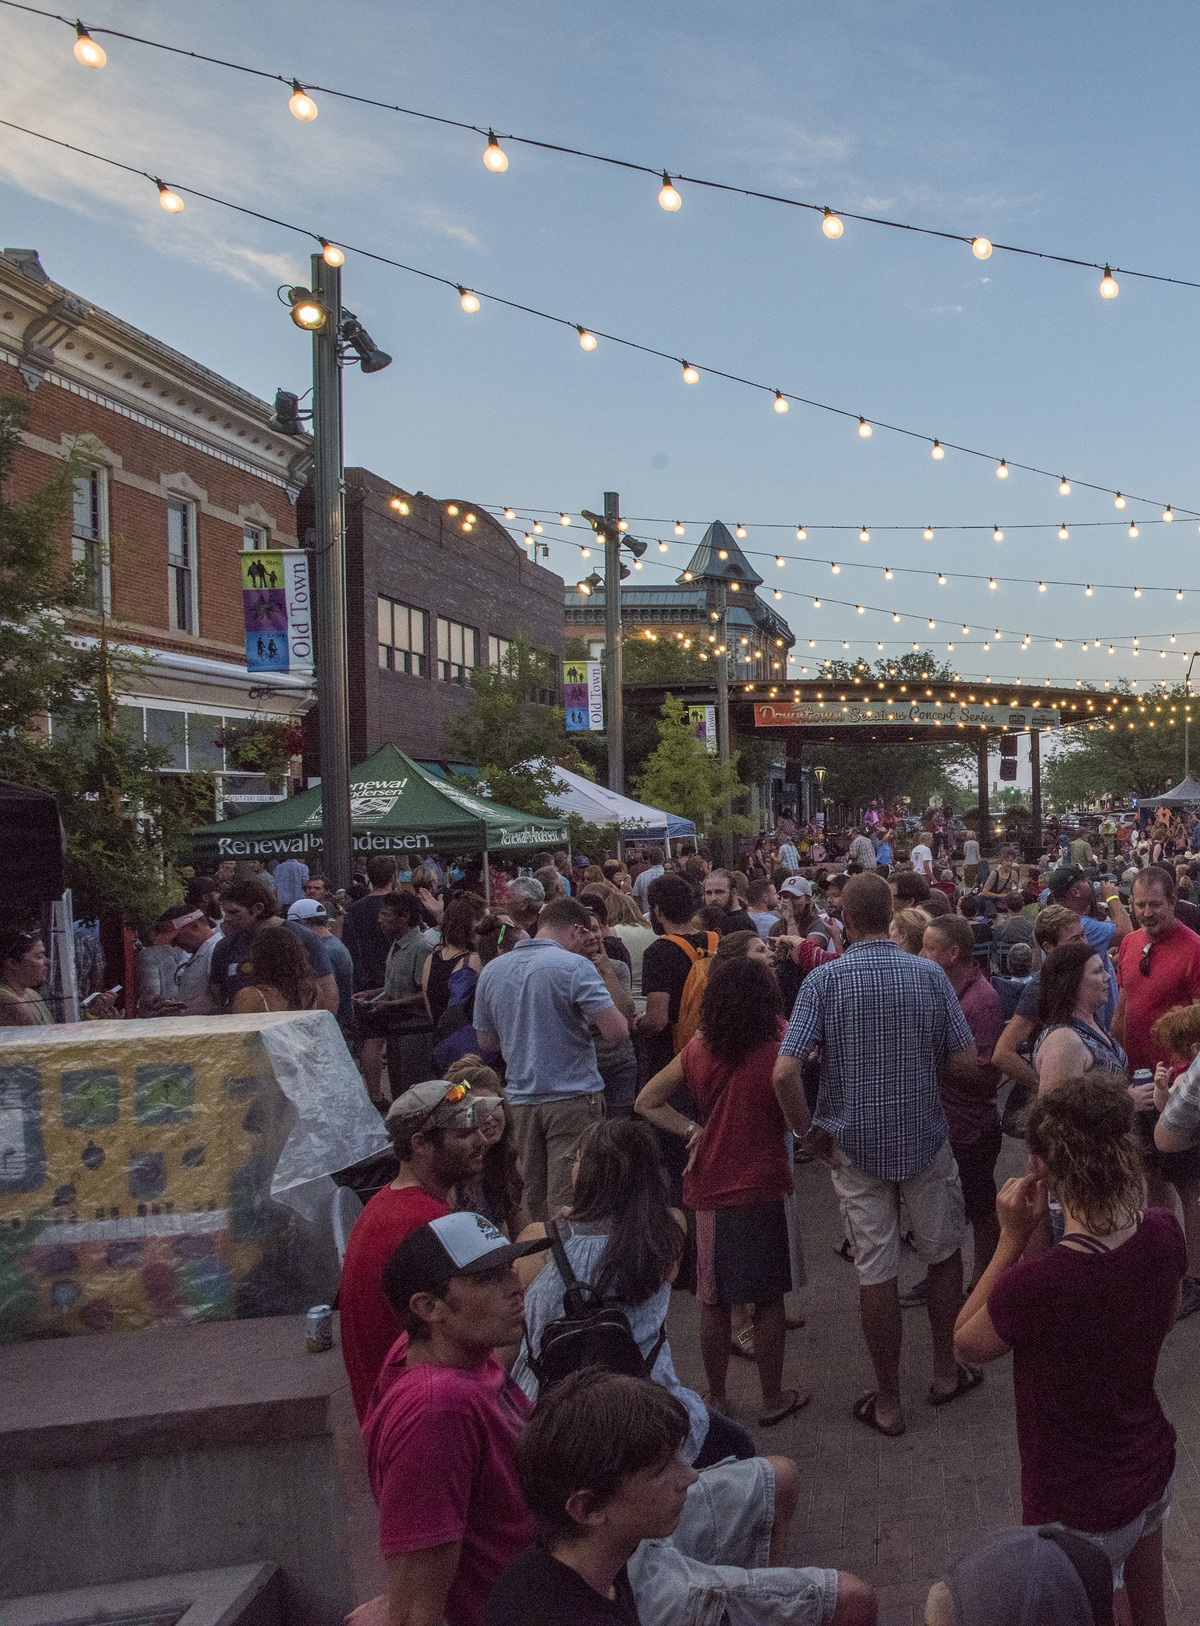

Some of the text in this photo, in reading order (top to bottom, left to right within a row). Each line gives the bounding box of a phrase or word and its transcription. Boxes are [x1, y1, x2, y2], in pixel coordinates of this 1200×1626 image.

[290, 562, 311, 658] Old Town
[590, 668, 602, 724] Old Town
[707, 710, 715, 733] Town
[759, 704, 846, 725] Downtown
[848, 706, 906, 723] Sessions
[908, 705, 956, 721] Concert
[959, 707, 996, 723] Series
[350, 777, 408, 791] newal
[218, 832, 309, 855] Renewal
[351, 831, 435, 849] ndersen.
